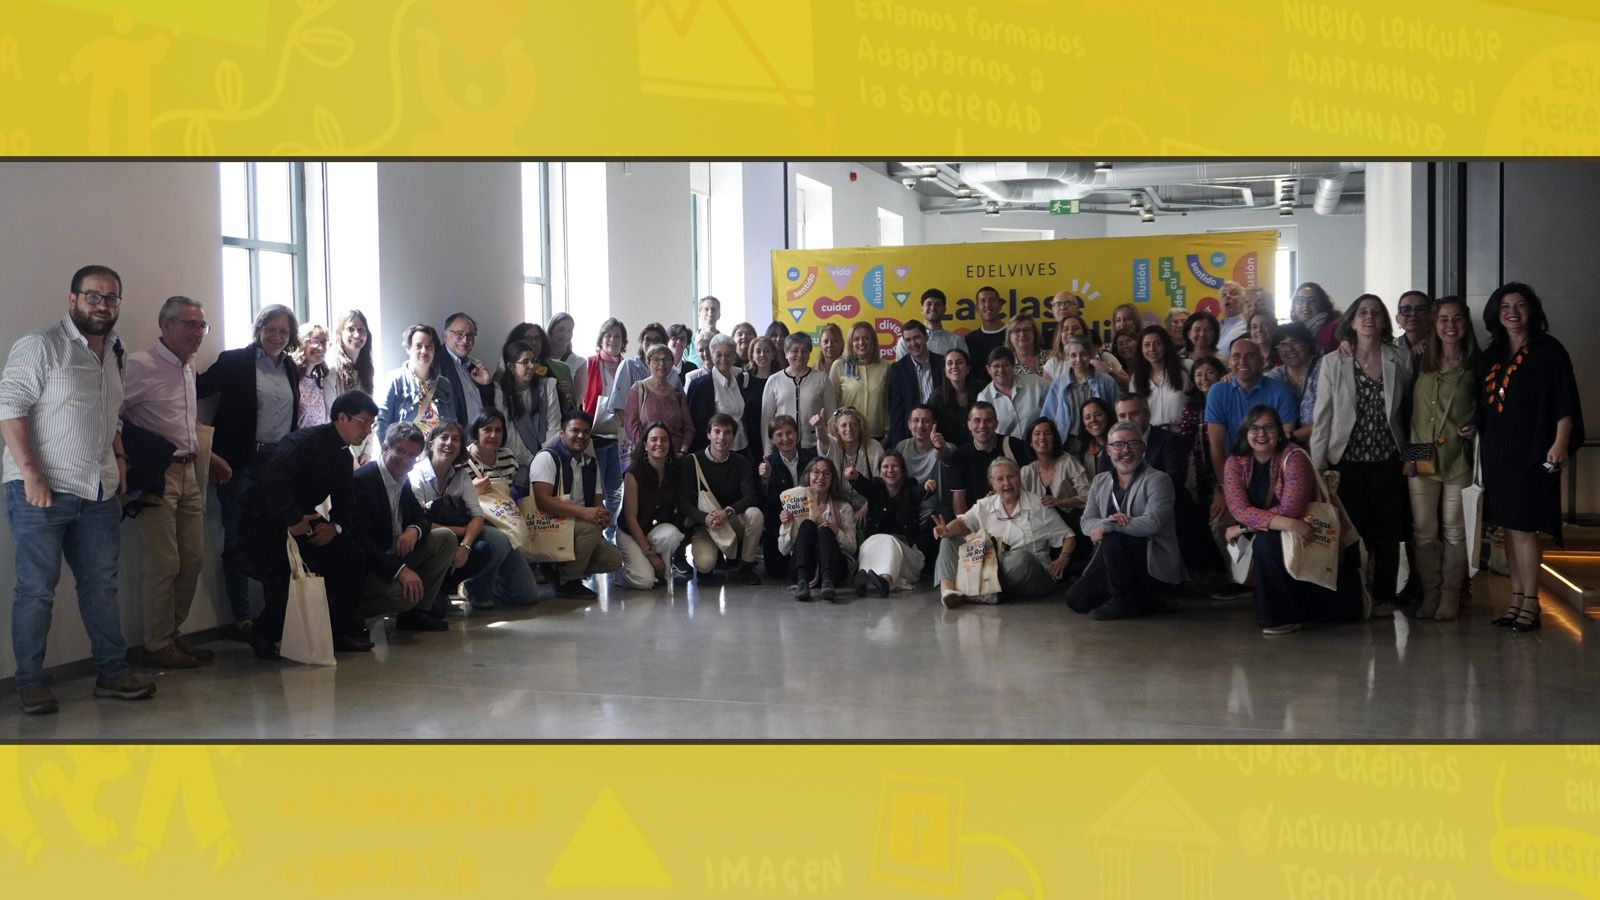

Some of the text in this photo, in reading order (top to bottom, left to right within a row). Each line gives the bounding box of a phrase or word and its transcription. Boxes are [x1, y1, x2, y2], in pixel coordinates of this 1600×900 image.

[831, 266, 852, 276] vida
[966, 262, 1057, 278] EDELVIVES
[1161, 260, 1171, 279] brir
[1190, 261, 1218, 287] sentido
[793, 273, 816, 298] sentido
[873, 270, 882, 304] ilusión
[1137, 263, 1146, 298] ilusión
[1170, 278, 1178, 290] cu
[1175, 289, 1184, 306] des
[821, 302, 853, 312] cuidar
